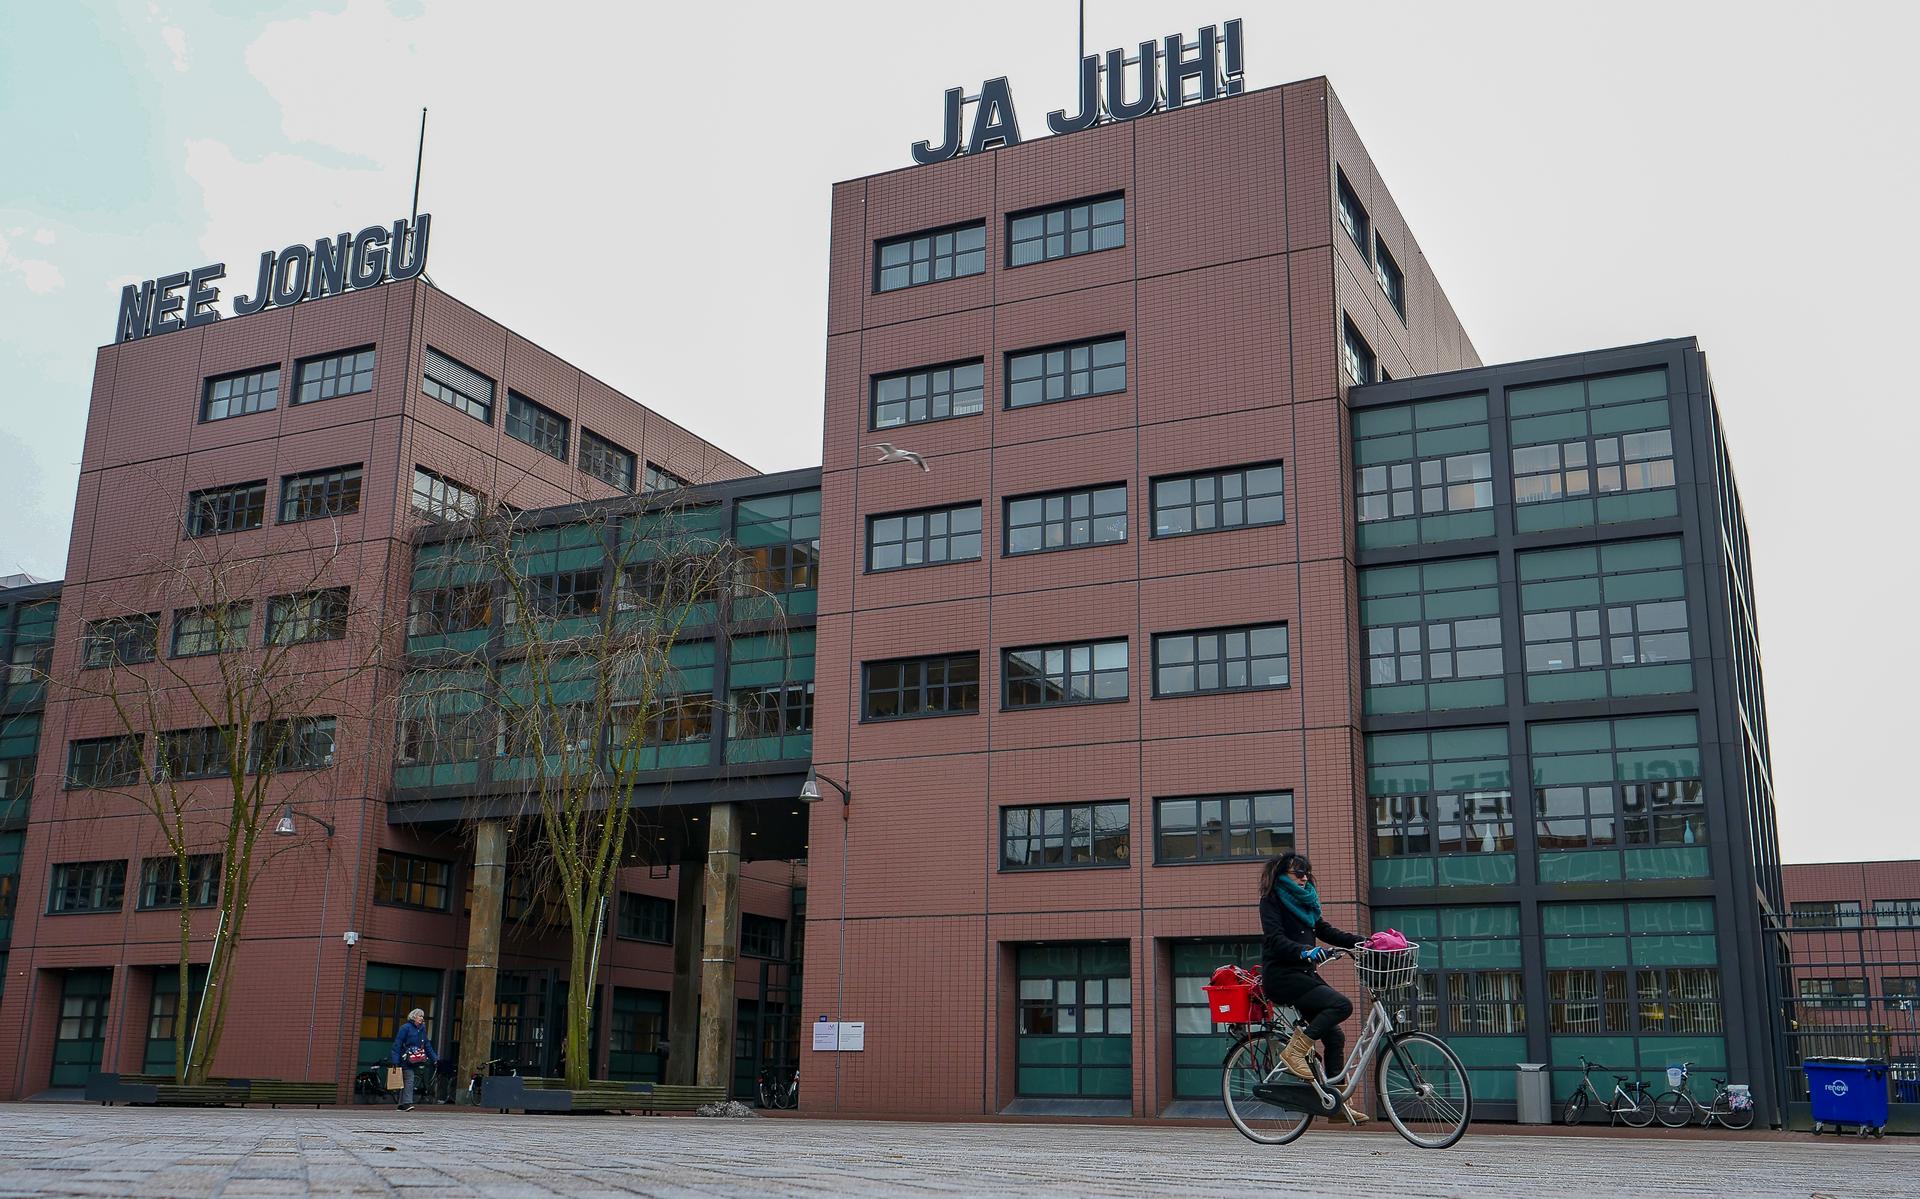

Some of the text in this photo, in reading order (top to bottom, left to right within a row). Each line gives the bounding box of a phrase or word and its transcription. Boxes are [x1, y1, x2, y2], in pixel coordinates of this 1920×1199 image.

[911, 18, 1245, 165] JA JUH!
[115, 213, 431, 344] NEE JONGU
[1824, 1083, 1849, 1093] renewi
